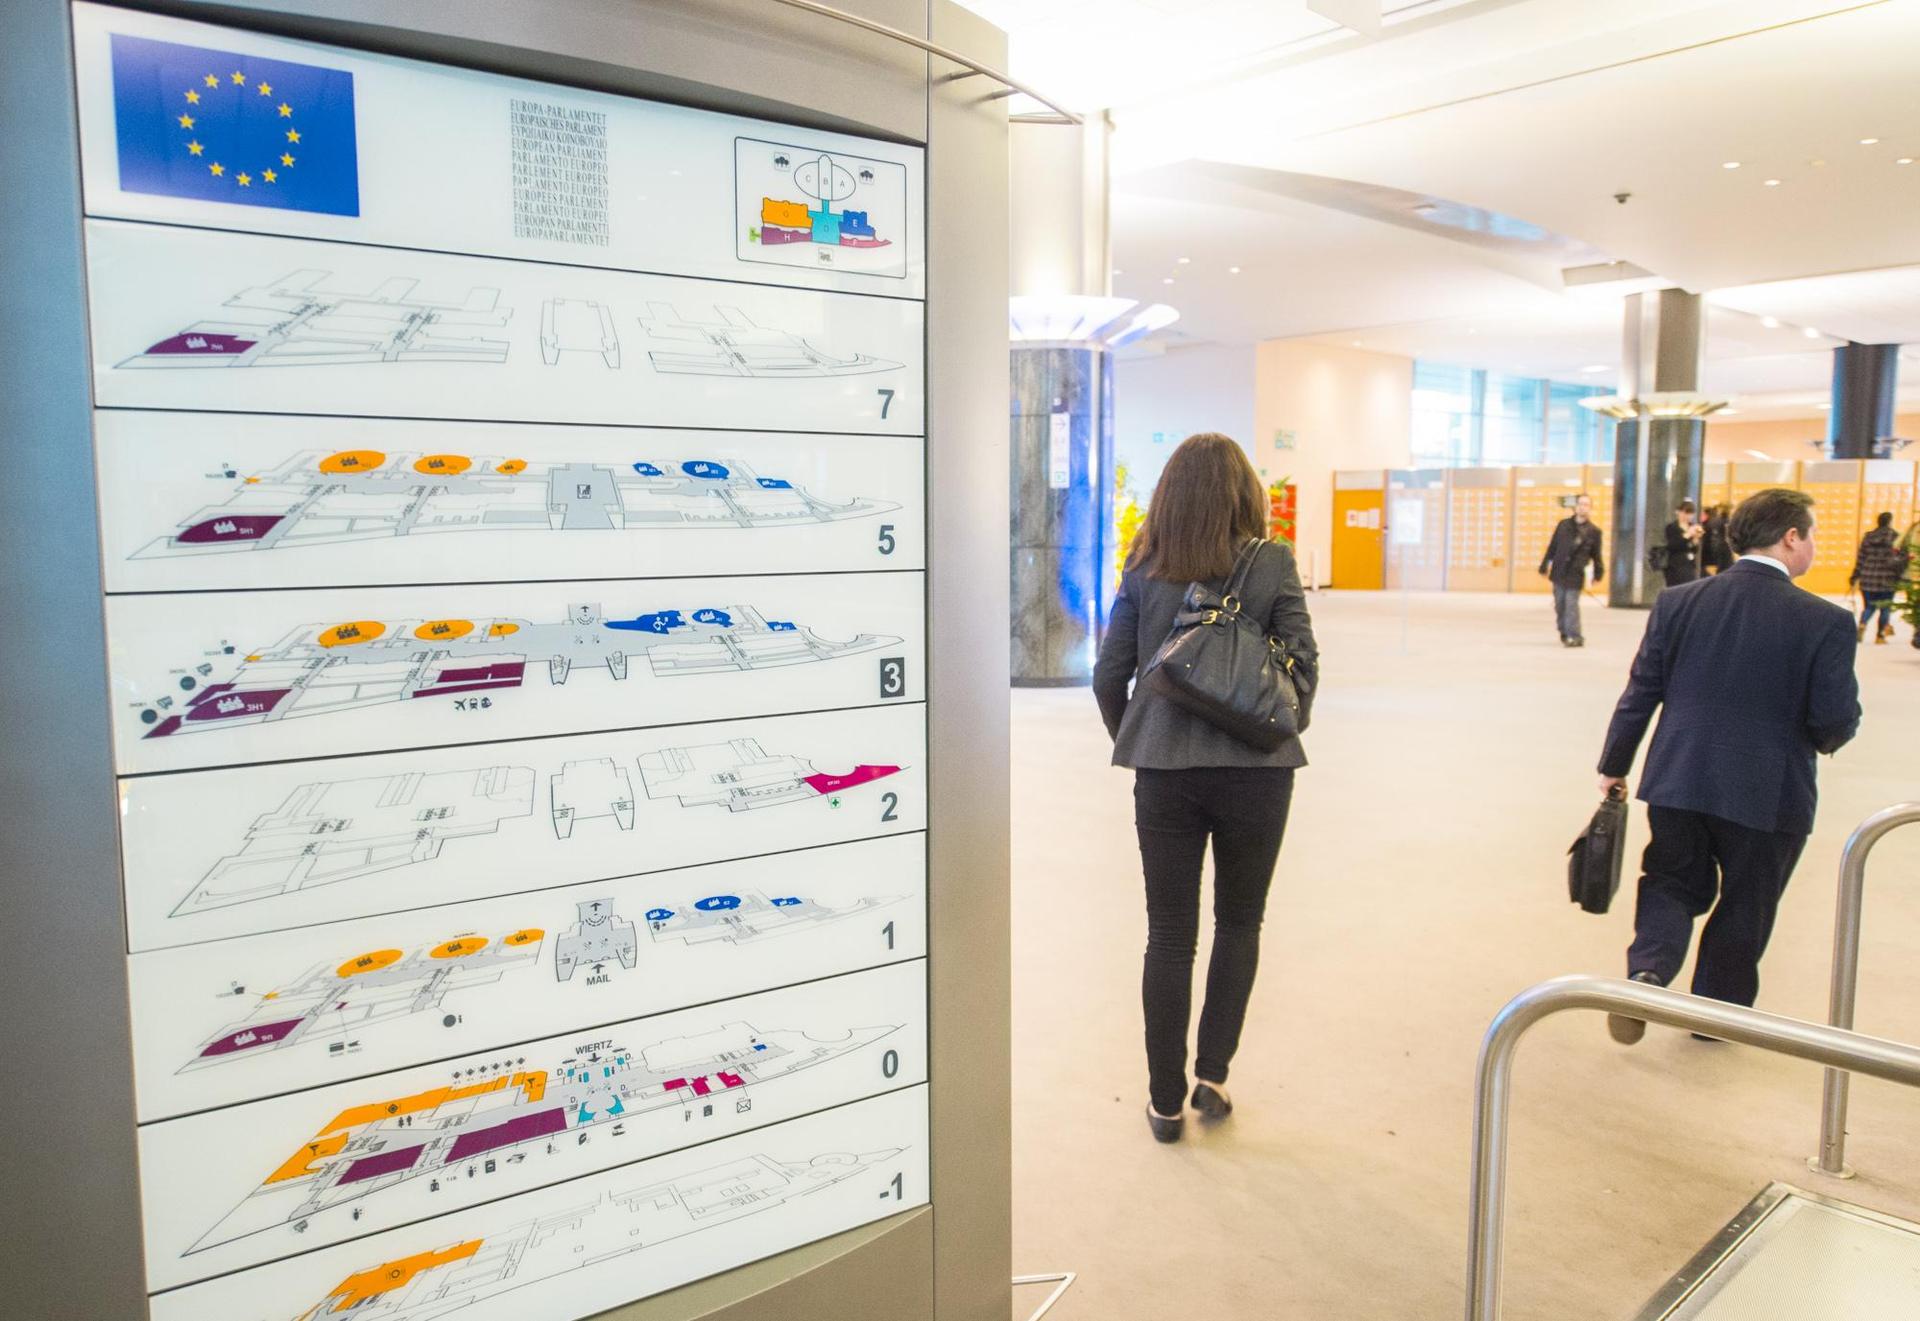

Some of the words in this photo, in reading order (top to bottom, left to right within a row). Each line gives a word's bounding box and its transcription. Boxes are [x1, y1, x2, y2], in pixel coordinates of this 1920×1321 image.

[511, 137, 555, 153] EUROPEAN
[557, 143, 608, 161] PARLIAMENT
[878, 389, 895, 420] 7
[878, 525, 896, 555] 5
[884, 662, 901, 693] 3
[247, 703, 264, 712] 3H1
[881, 792, 898, 822] 2
[882, 921, 894, 950] 1
[586, 974, 612, 986] MAIL
[575, 1039, 613, 1055] WIERTZ
[882, 1049, 899, 1079] 0
[879, 1172, 902, 1201] -1
